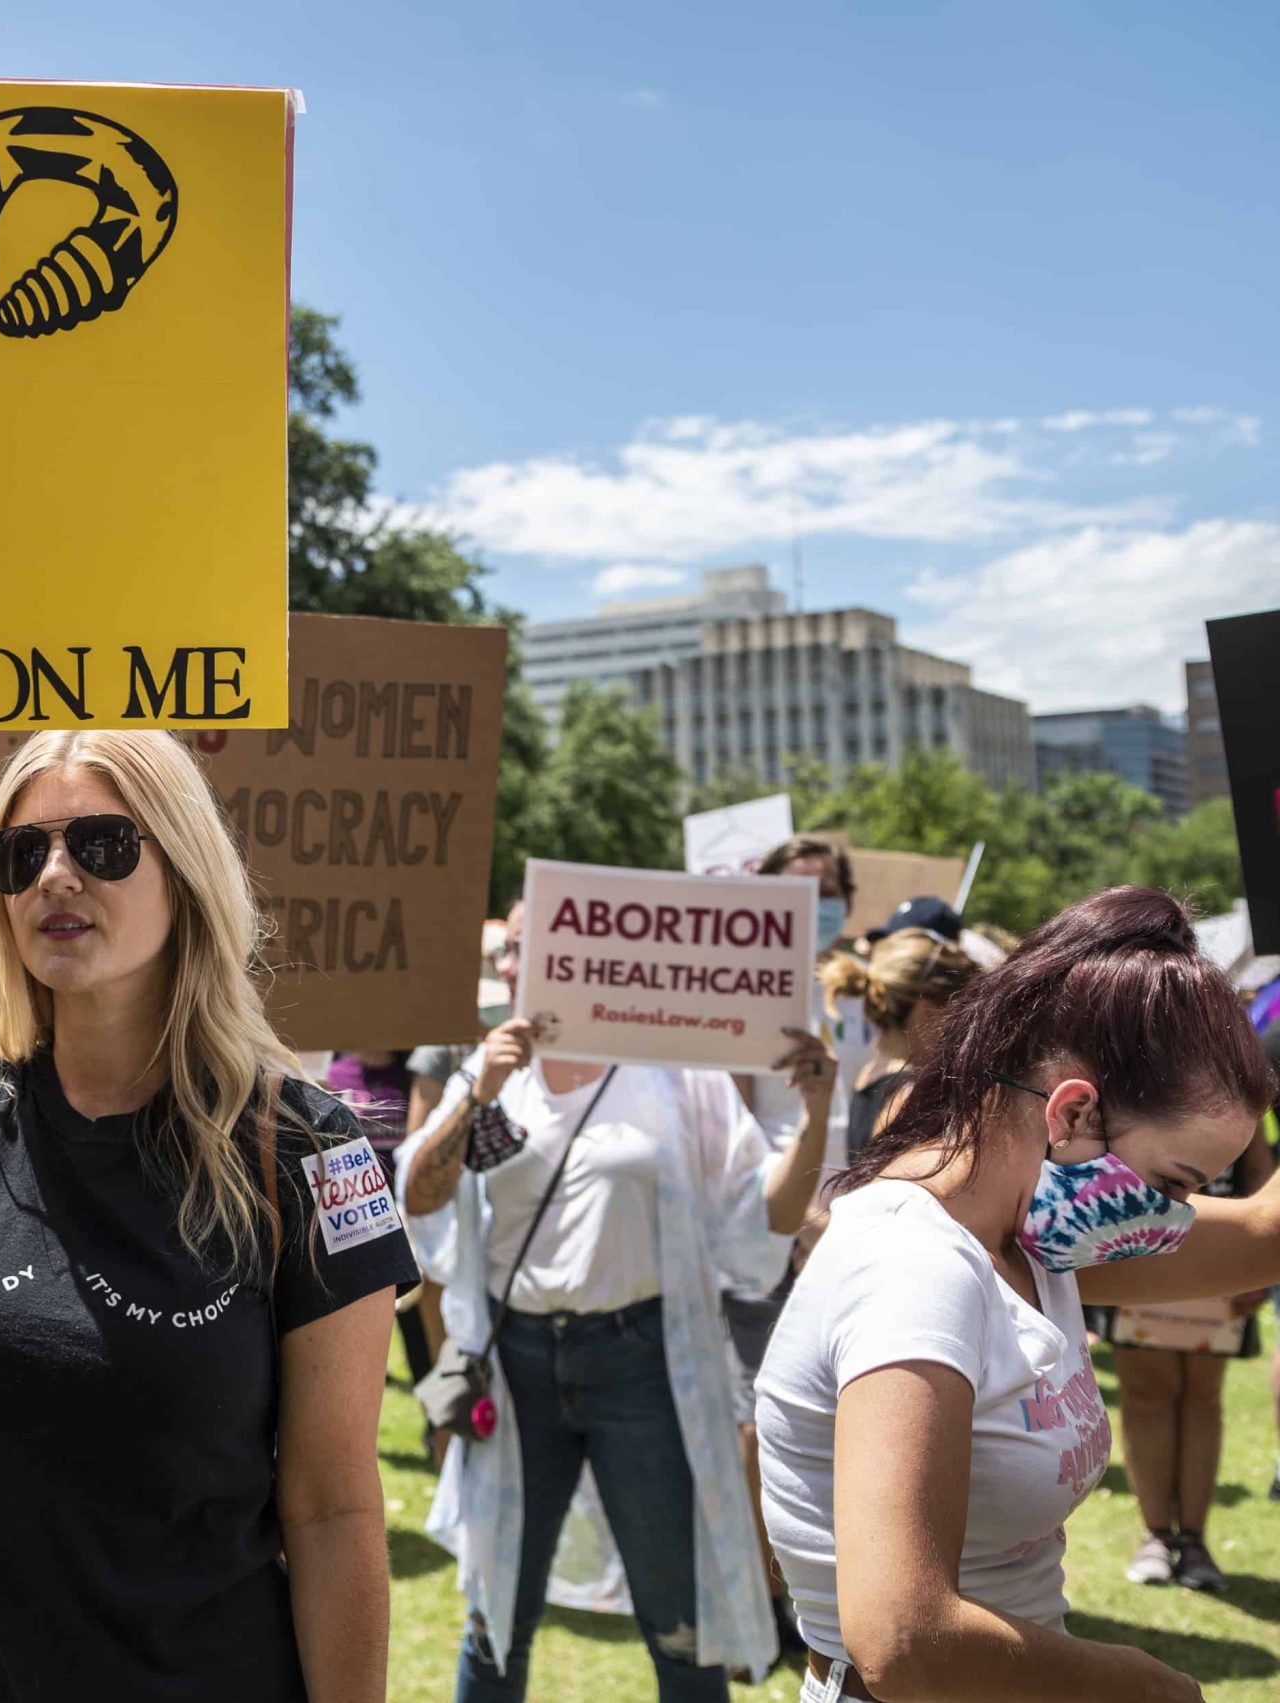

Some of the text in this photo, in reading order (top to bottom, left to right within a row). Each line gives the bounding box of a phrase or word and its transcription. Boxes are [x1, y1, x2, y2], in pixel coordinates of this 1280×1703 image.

[123, 645, 252, 722] ME
[265, 677, 473, 761] WOMEN
[549, 897, 794, 949] ABORTION
[546, 954, 794, 998] IS HEALTHCARE
[591, 1002, 746, 1037] RosiesLaw.org
[328, 1147, 373, 1175] #BeA
[311, 1164, 387, 1211] texas
[327, 1196, 391, 1231] VOTER
[333, 1216, 394, 1244] INDIVISIBLE AUSTIN
[86, 1273, 122, 1307] IT'S
[126, 1302, 162, 1325] MY
